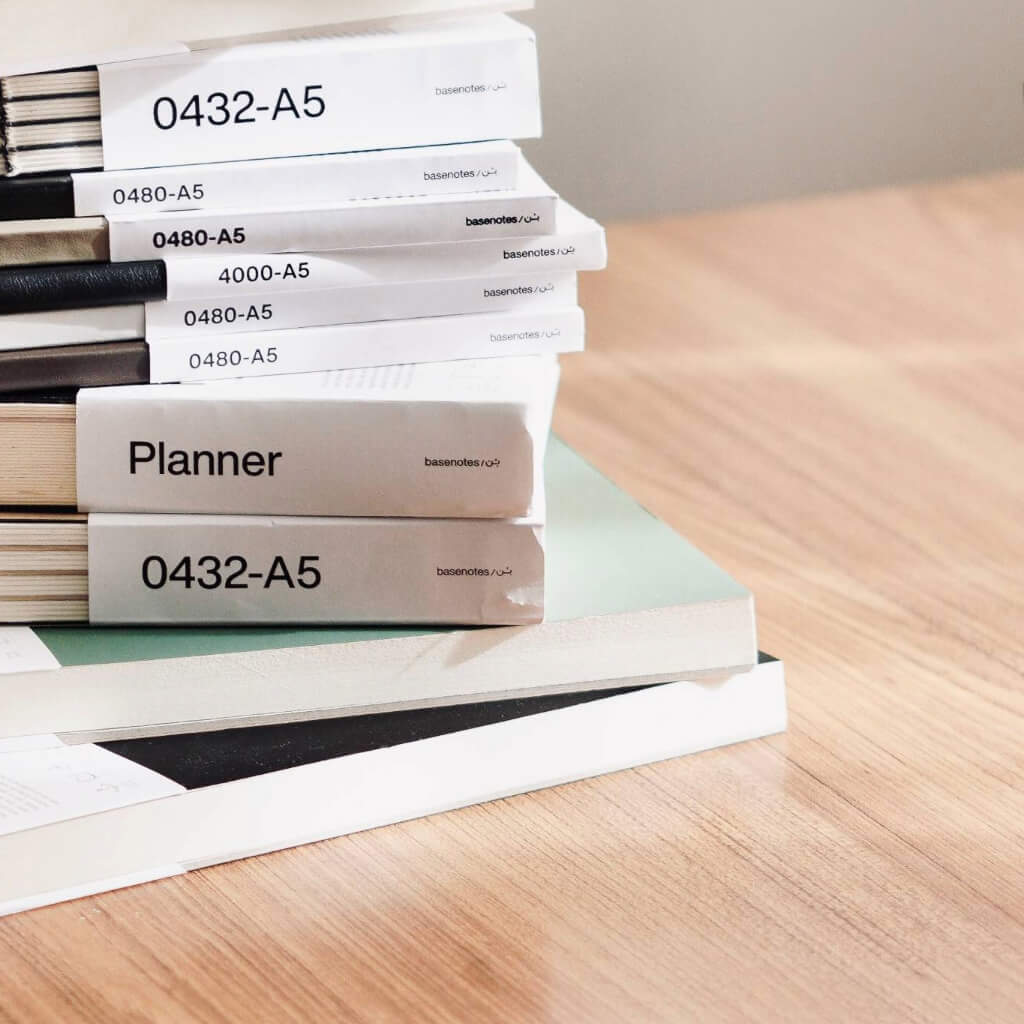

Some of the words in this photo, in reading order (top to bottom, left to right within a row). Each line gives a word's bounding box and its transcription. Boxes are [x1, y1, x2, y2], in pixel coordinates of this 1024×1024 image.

[153, 84, 326, 131] 0432-A5
[113, 183, 205, 206] 0480-A5
[152, 227, 246, 249] 0480-A5
[218, 262, 311, 285] 4000-A5
[184, 303, 274, 327] 0480-A5
[189, 347, 279, 370] 0480-A5
[129, 440, 283, 477] Planner
[141, 555, 322, 590] 0432-A5
